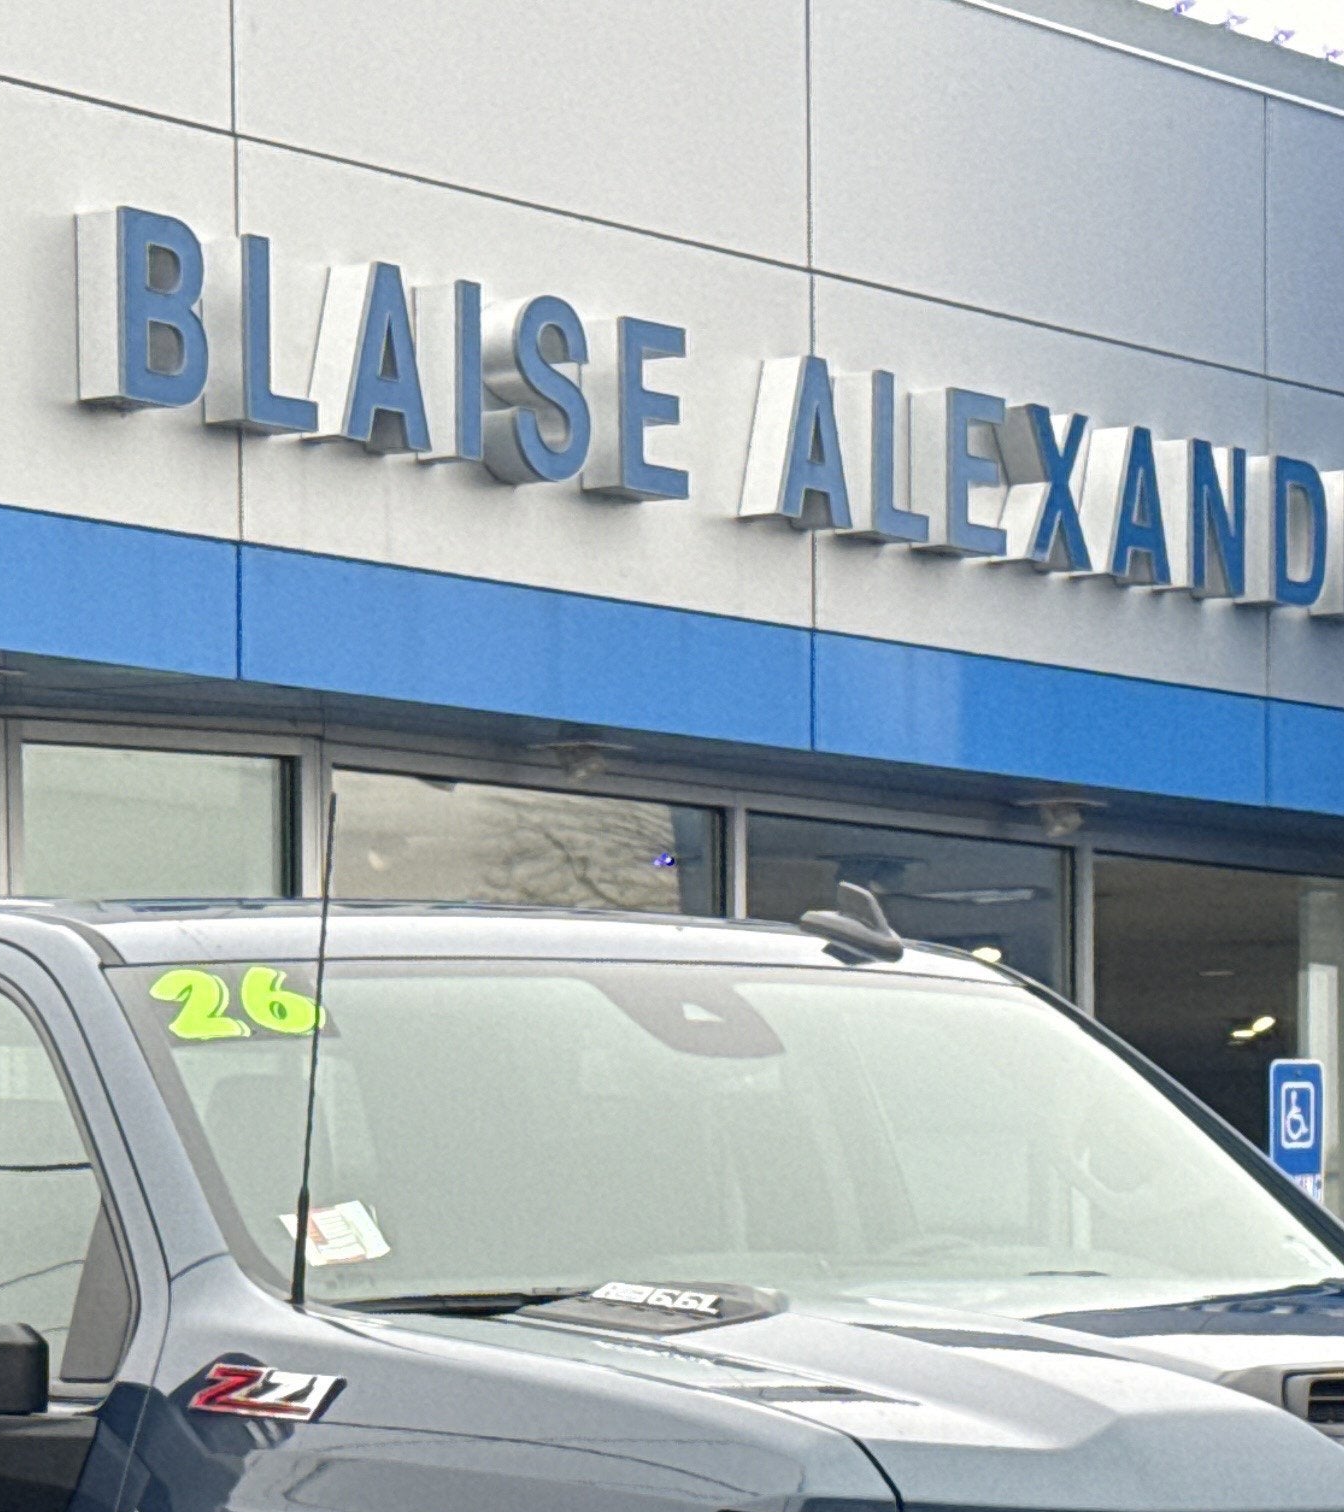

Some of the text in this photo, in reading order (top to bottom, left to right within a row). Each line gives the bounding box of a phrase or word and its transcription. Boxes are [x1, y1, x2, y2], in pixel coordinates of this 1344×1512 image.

[112, 205, 691, 502] BLAISE
[149, 966, 325, 1040] 26
[188, 1362, 343, 1422] Z71
